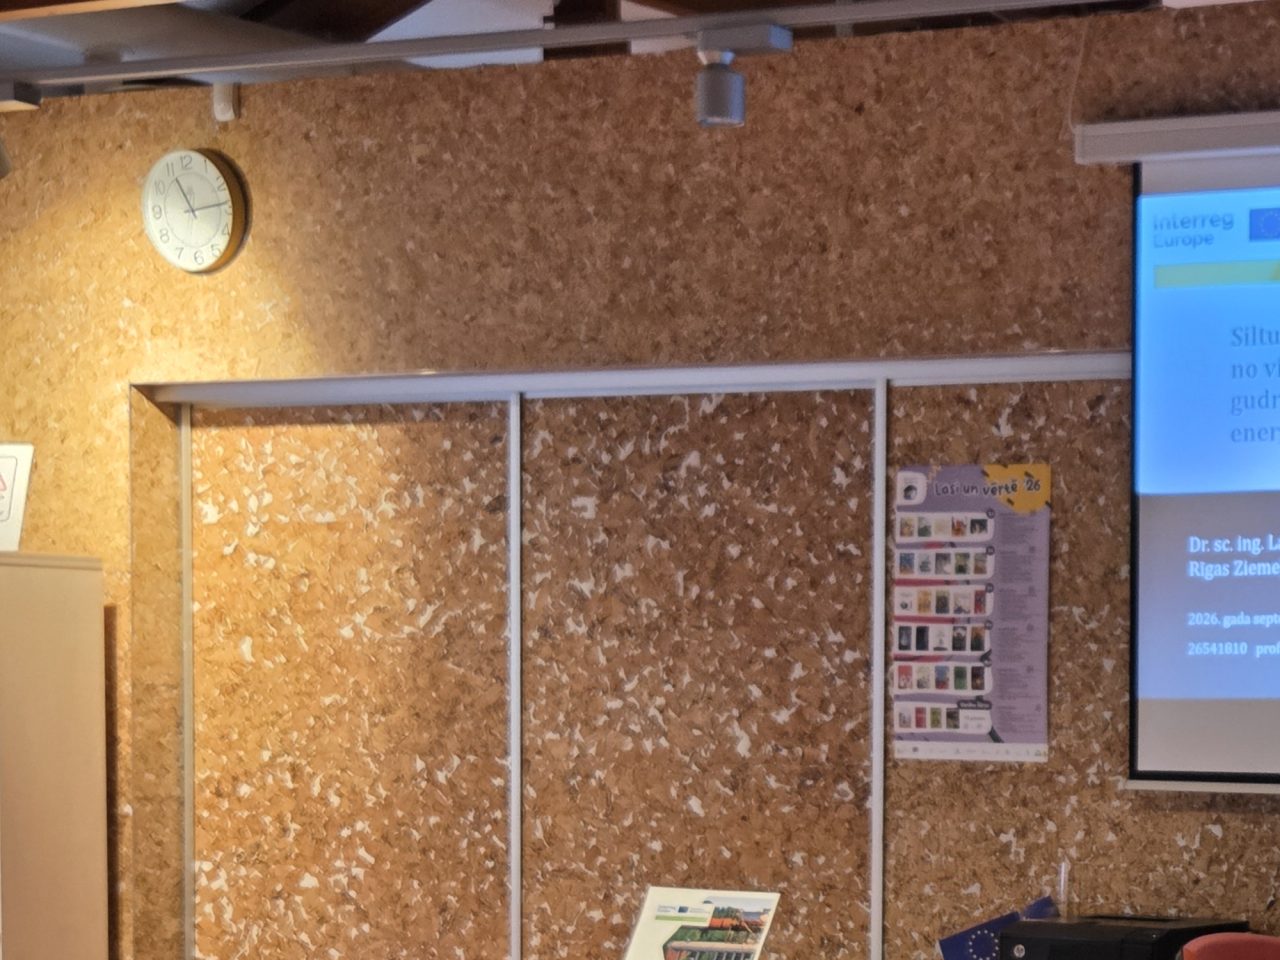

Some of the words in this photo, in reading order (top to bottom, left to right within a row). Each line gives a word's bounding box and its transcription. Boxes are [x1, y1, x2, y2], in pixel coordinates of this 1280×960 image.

[166, 162, 175, 177] 11
[180, 154, 193, 170] 12
[154, 180, 166, 196] 10
[152, 204, 162, 220] 9
[1153, 212, 1234, 231] Interreg
[160, 228, 170, 244] 8
[221, 223, 231, 237] 4
[1153, 231, 1215, 249] Europe
[175, 247, 184, 259] 7
[194, 250, 204, 265] 6
[211, 243, 221, 258] 5
[1231, 363, 1258, 379] no
[963, 485, 978, 494] un
[1189, 536, 1209, 552] Dr.
[1214, 538, 1233, 552] sc.
[1237, 536, 1264, 555] ing.
[1188, 612, 1221, 626] 2026.
[1223, 611, 1251, 629] gada
